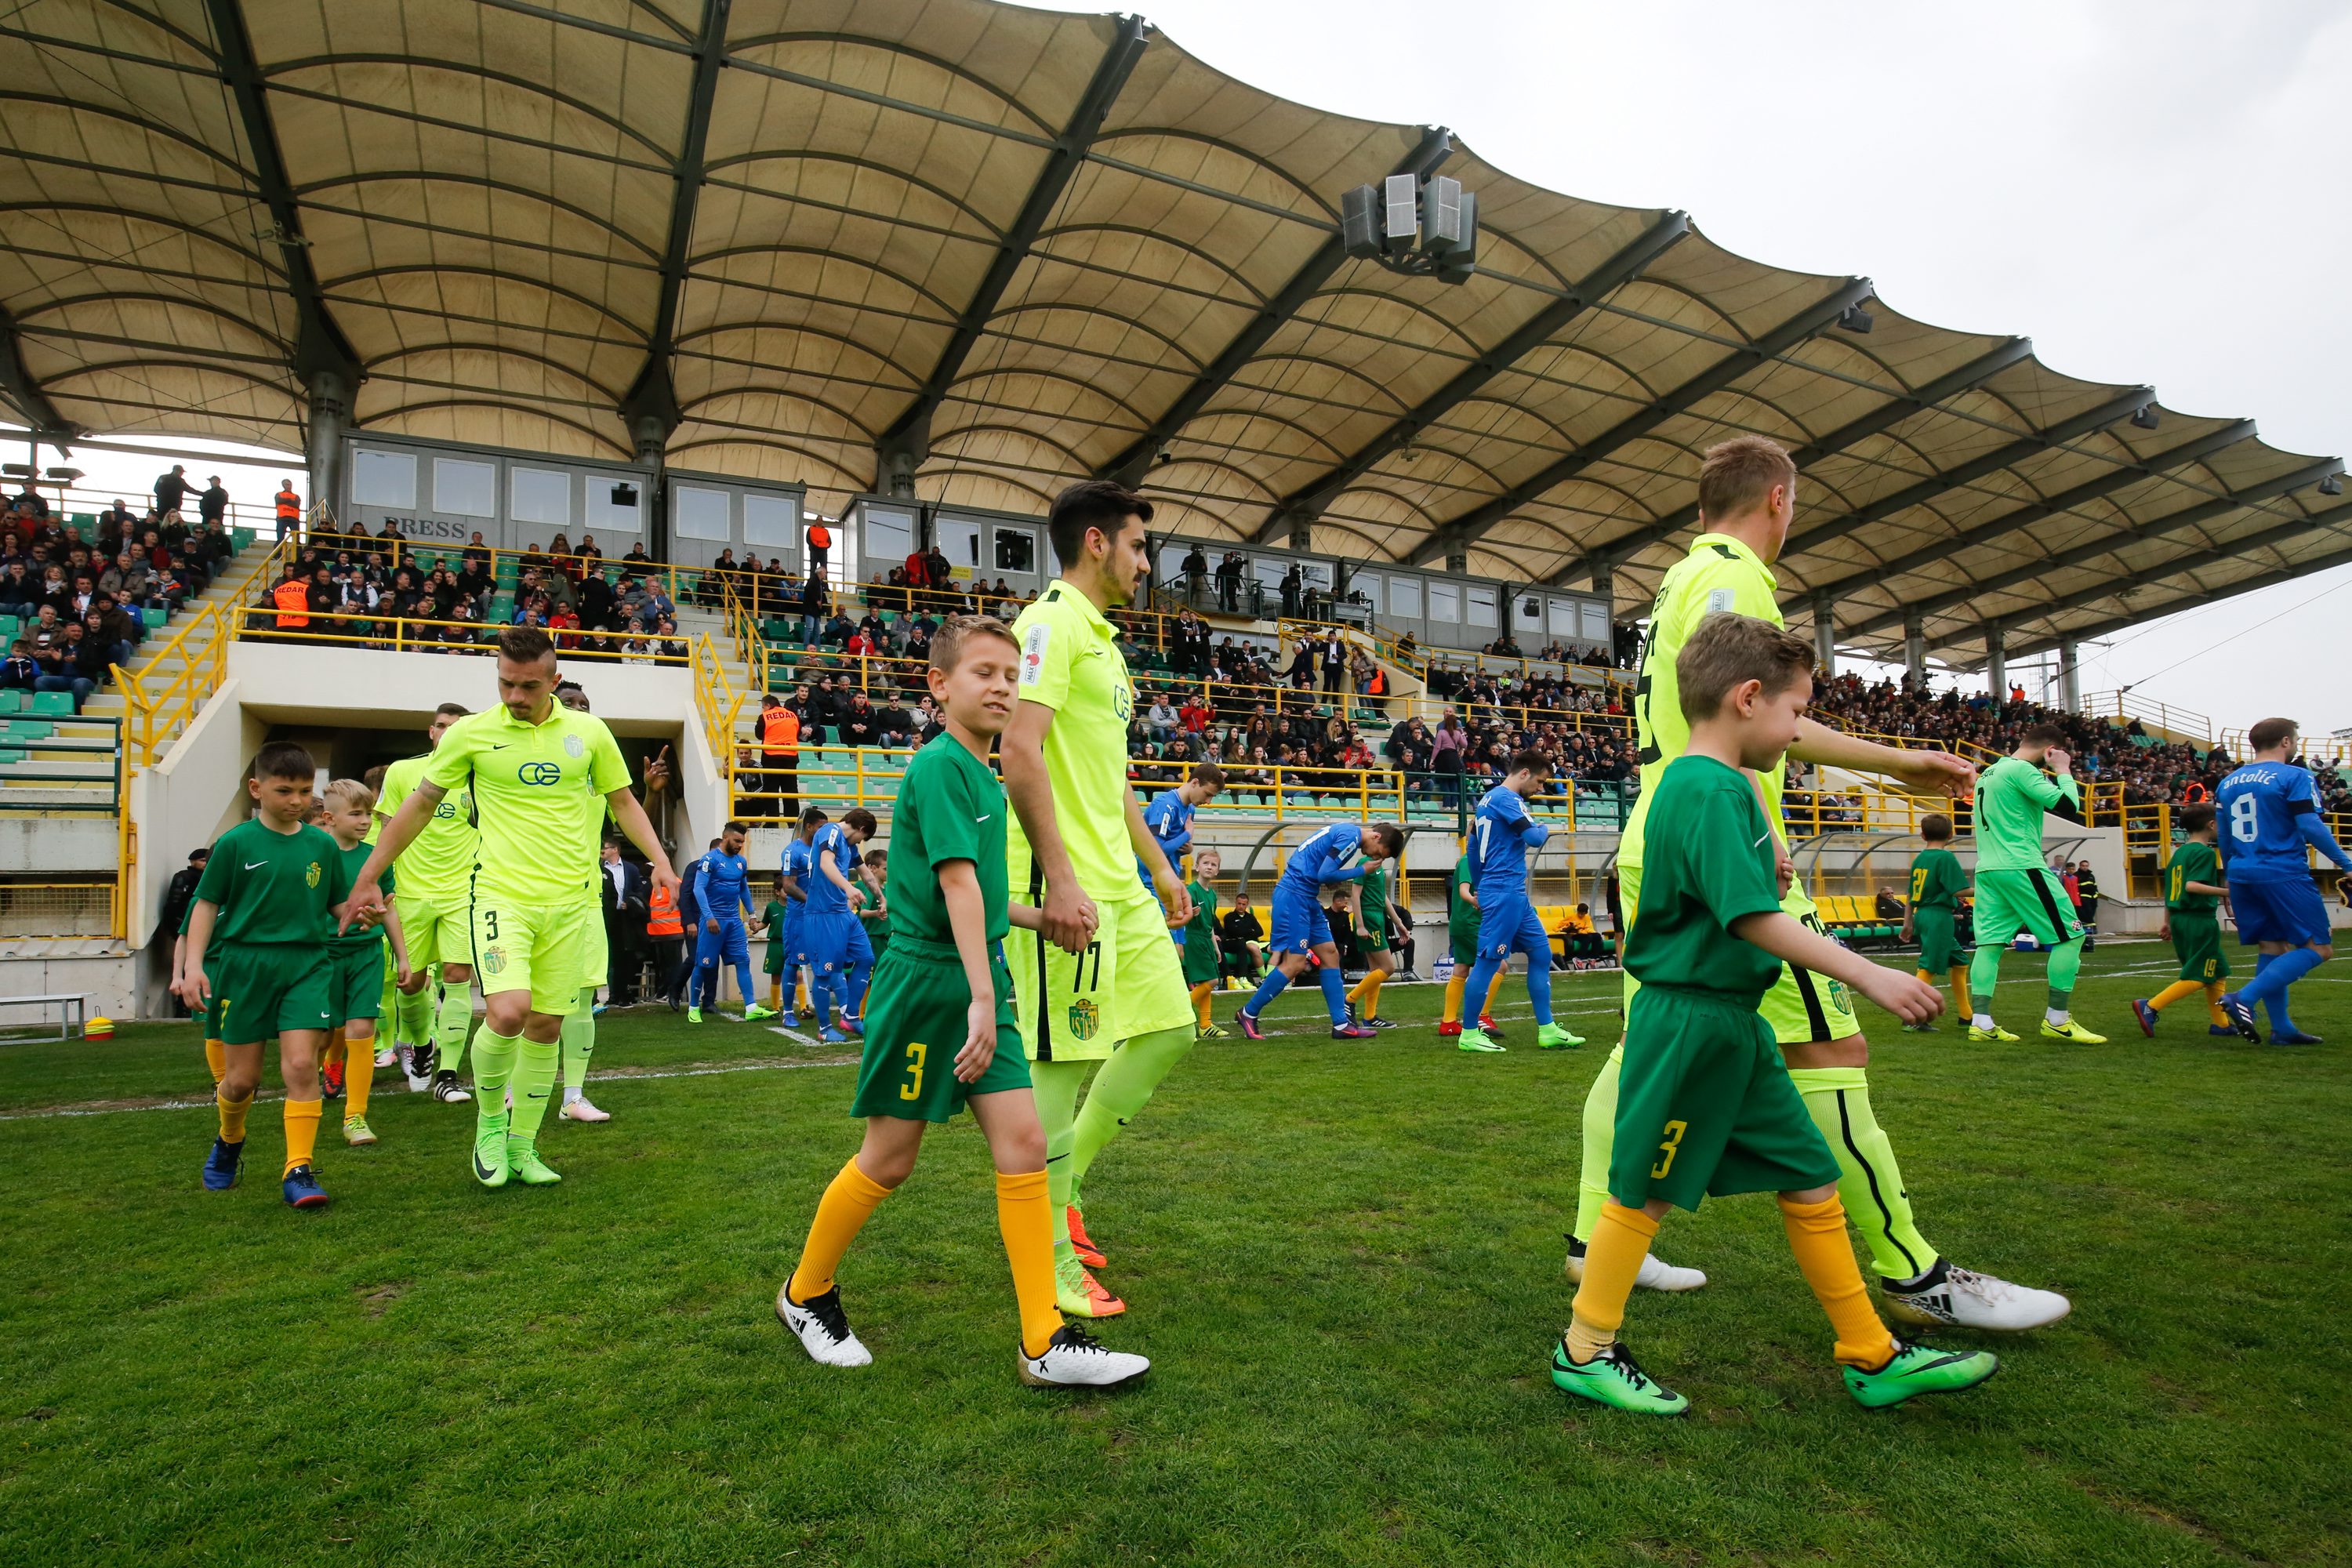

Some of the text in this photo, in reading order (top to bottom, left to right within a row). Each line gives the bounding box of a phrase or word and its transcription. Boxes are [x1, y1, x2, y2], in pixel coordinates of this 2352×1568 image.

[1272, 622, 1289, 633] VP
[766, 711, 797, 720] REDAR
[2223, 769, 2278, 790] antolić
[2230, 792, 2259, 844] 8
[1912, 868, 1929, 902] 21
[2169, 865, 2183, 902] 18
[485, 910, 499, 942] 3
[1071, 941, 1101, 993] 77
[2204, 958, 2217, 978] 19
[900, 1042, 927, 1101] 3
[1650, 1120, 1687, 1179] 3
[1911, 1298, 1959, 1324] adidas
